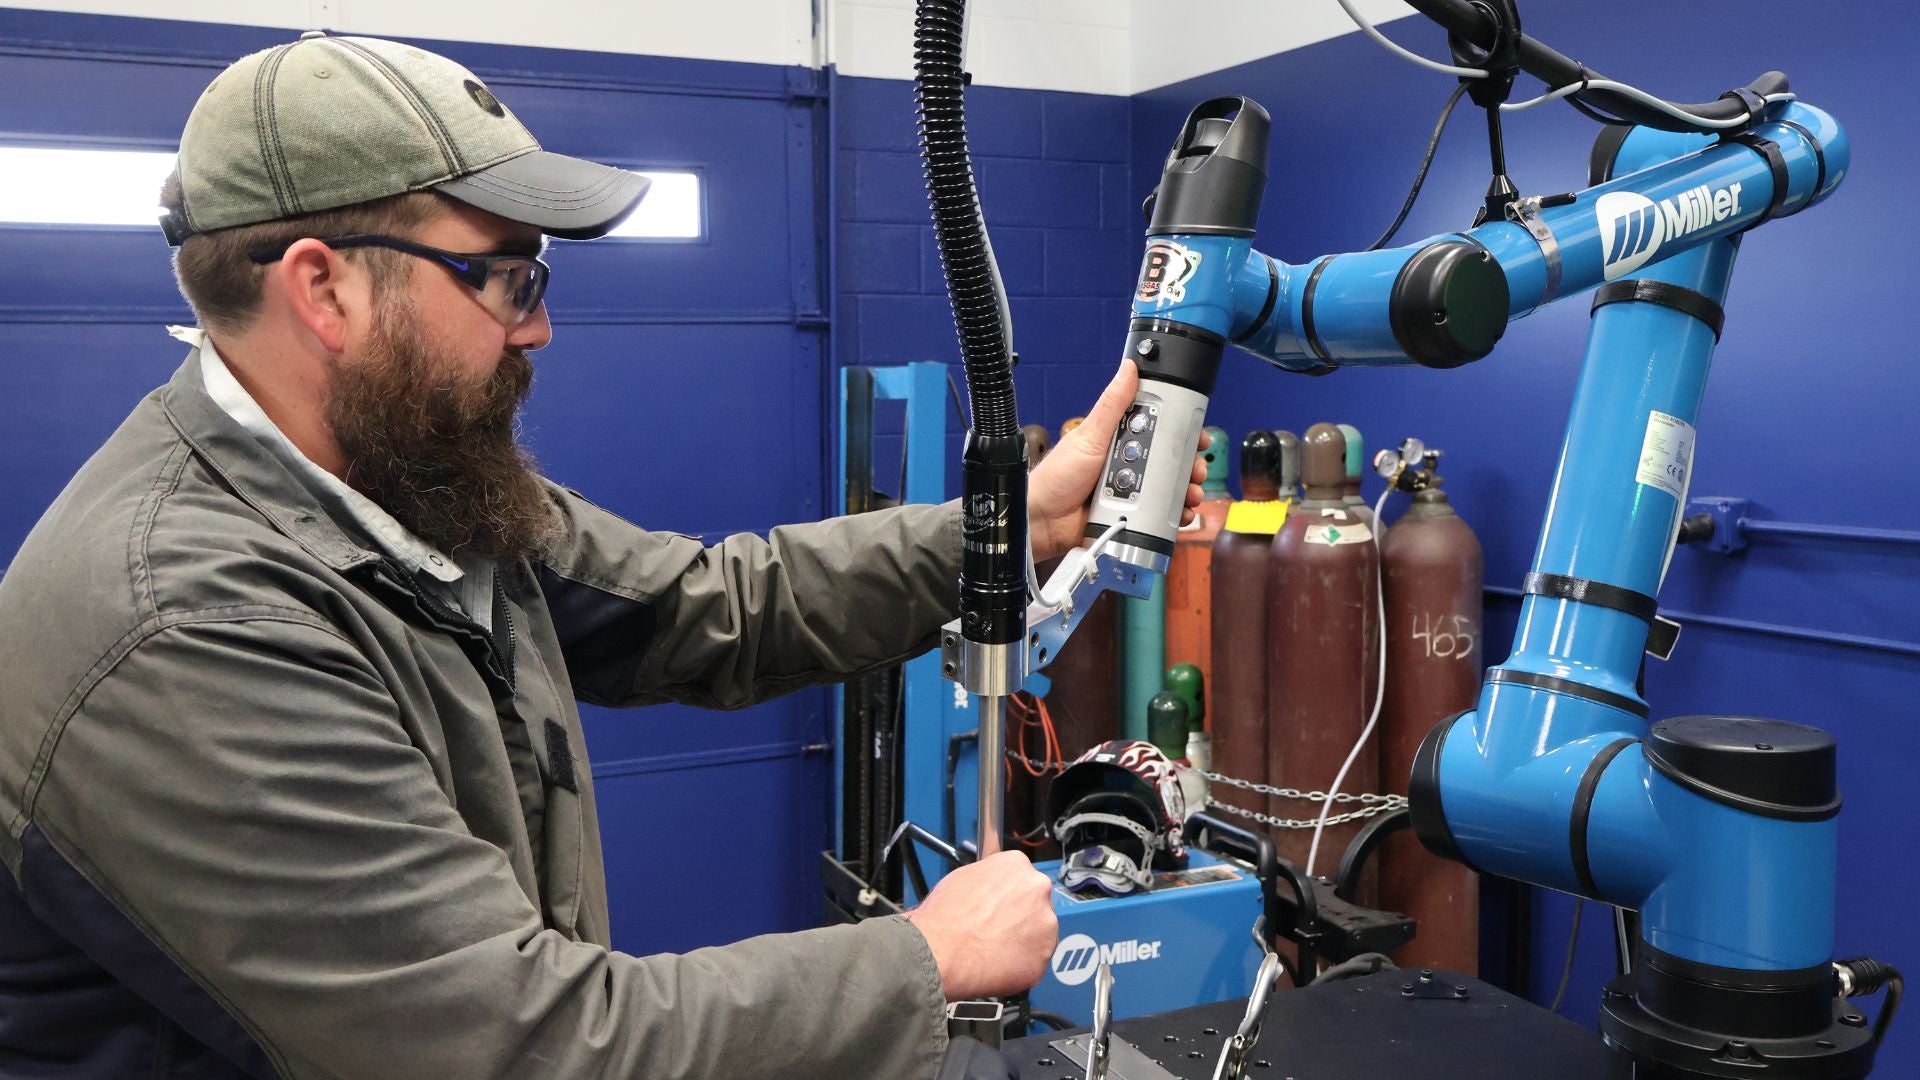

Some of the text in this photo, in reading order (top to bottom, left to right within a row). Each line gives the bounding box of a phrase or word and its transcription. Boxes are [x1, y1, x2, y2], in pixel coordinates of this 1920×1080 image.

[1659, 181, 1742, 243] Miller
[1412, 612, 1474, 660] 465
[1099, 939, 1161, 966] Miller
